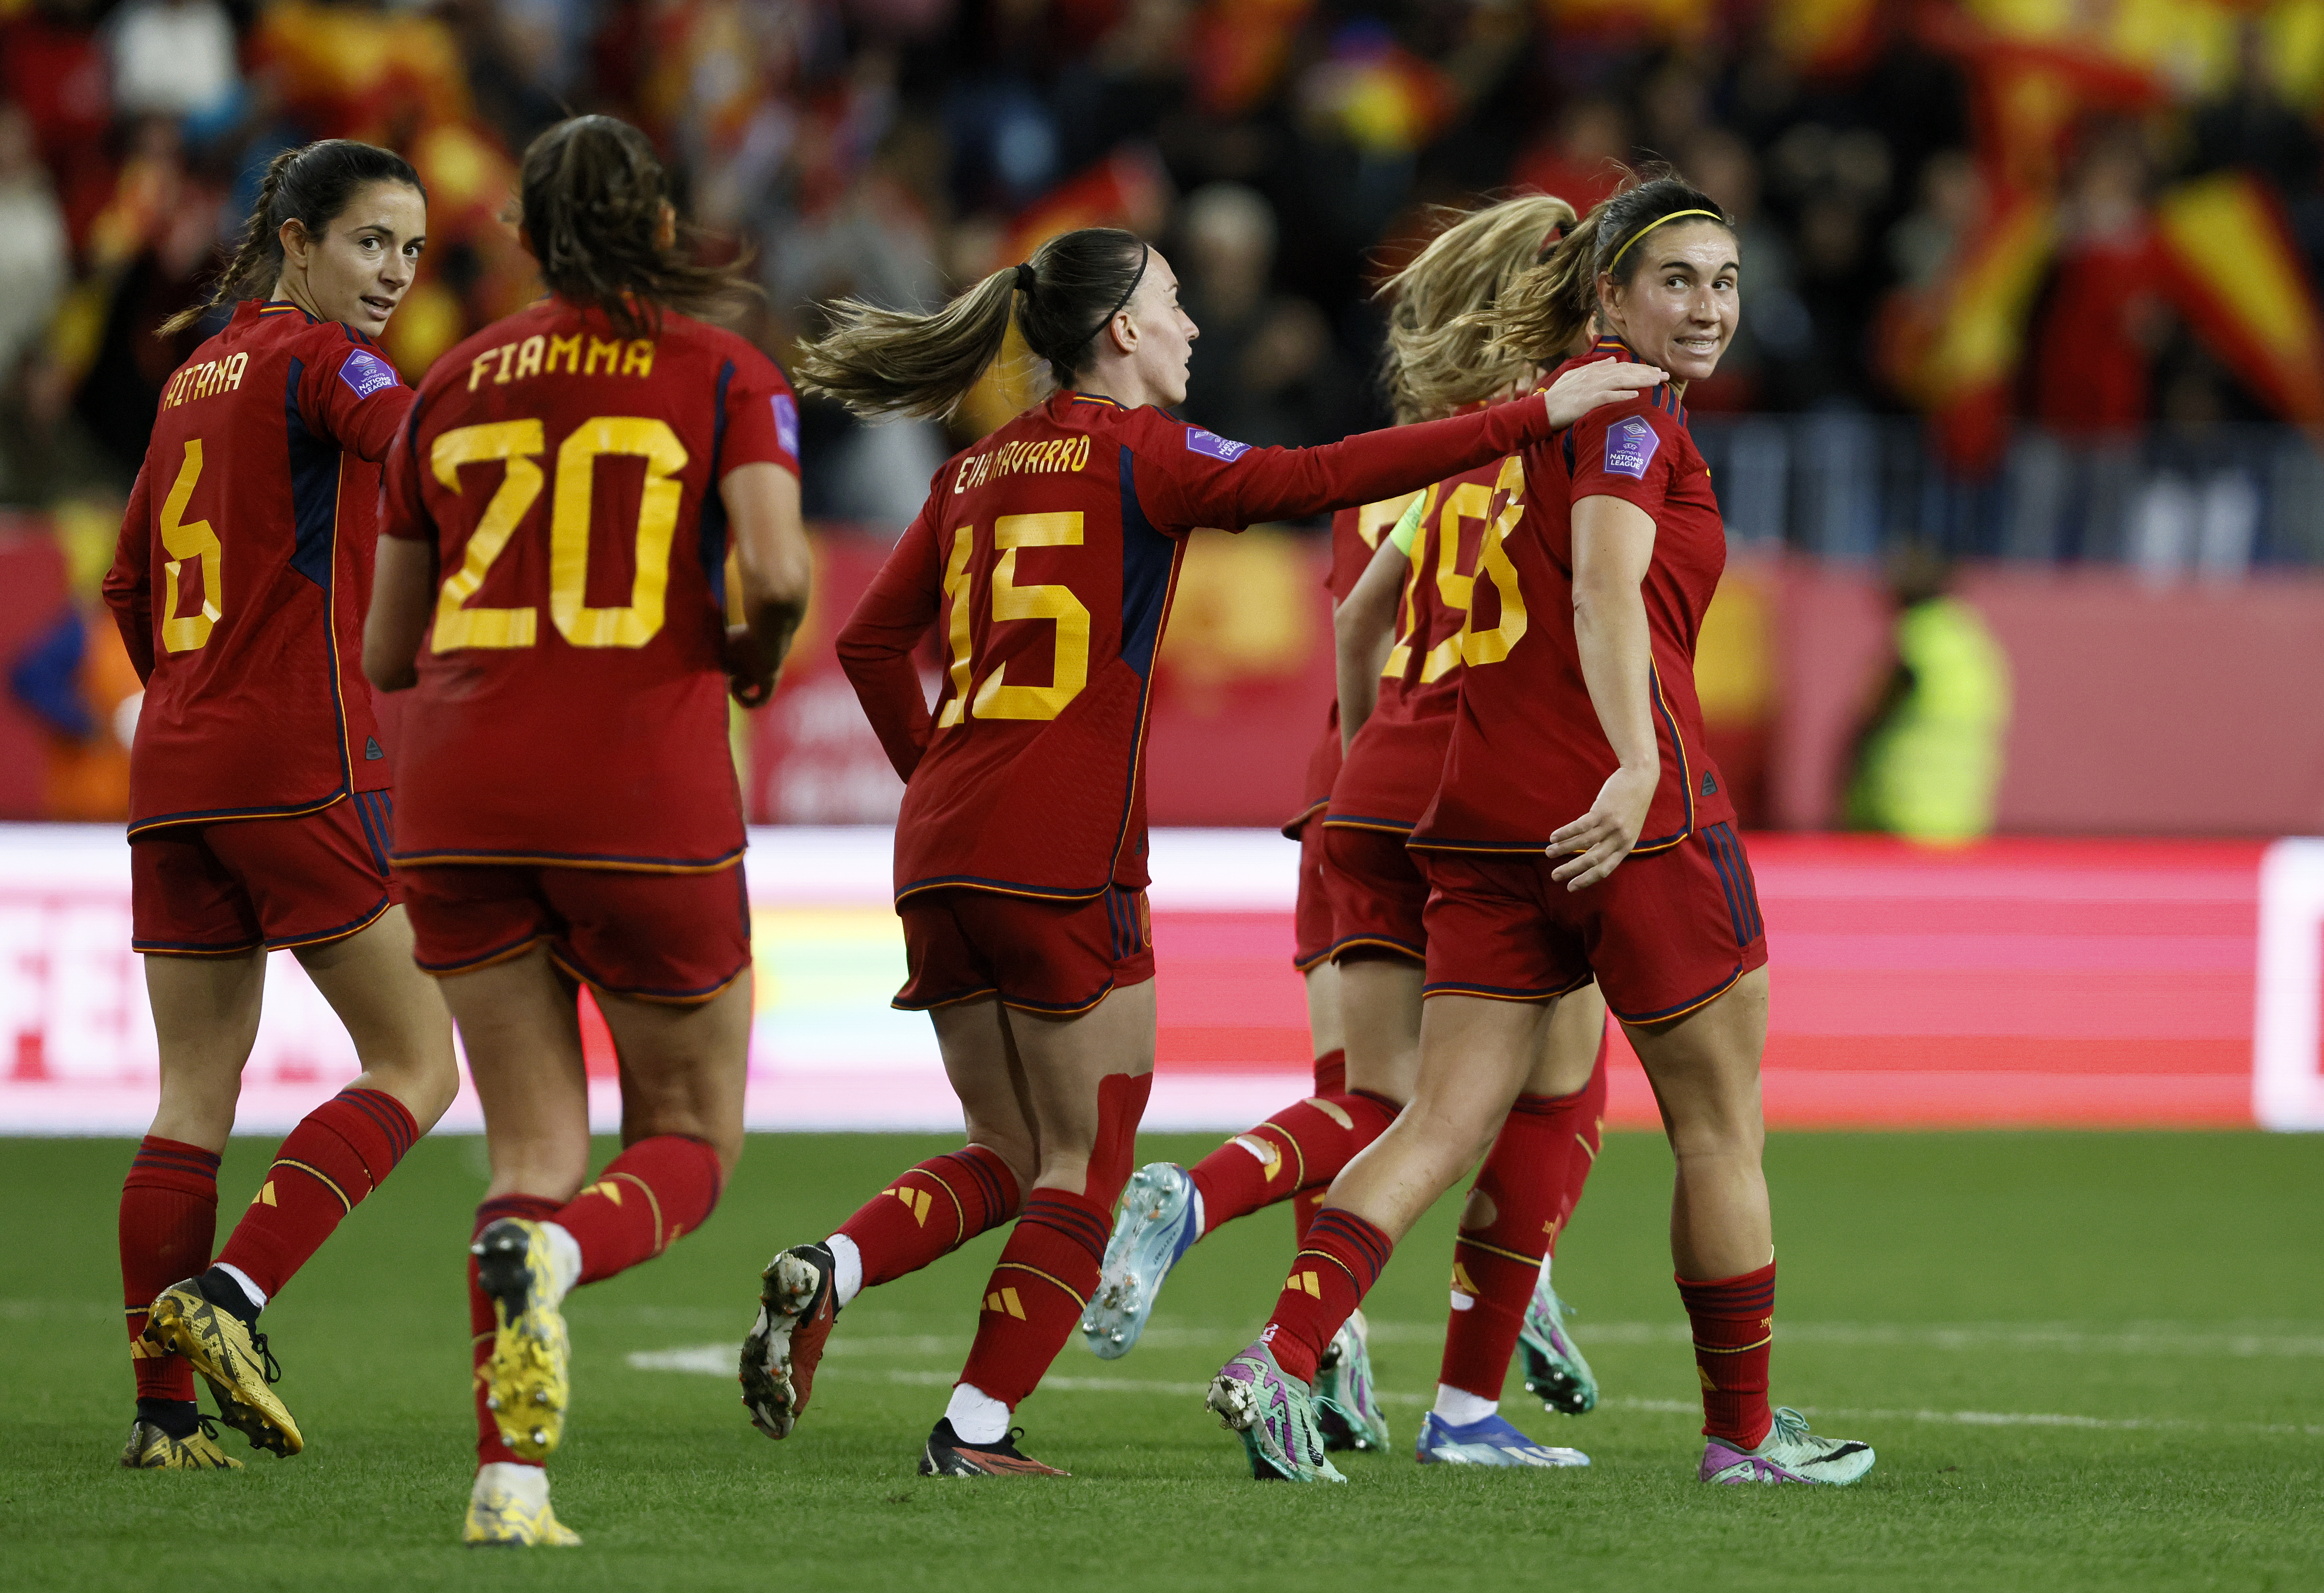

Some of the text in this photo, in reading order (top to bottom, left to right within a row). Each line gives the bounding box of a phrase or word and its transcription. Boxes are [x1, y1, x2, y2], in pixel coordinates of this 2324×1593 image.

[163, 352, 249, 411] AITANA
[359, 377, 391, 391] NATIONS
[361, 373, 385, 383] women's
[363, 381, 392, 394] LEAGUE
[468, 333, 655, 391] FIAMMA
[954, 434, 1090, 494] EVA NAVARRO
[1610, 453, 1644, 465] NATIONS
[1610, 460, 1640, 470] LEAGUE
[160, 439, 221, 653] 6
[431, 416, 688, 654] 20
[938, 511, 1090, 728] 15
